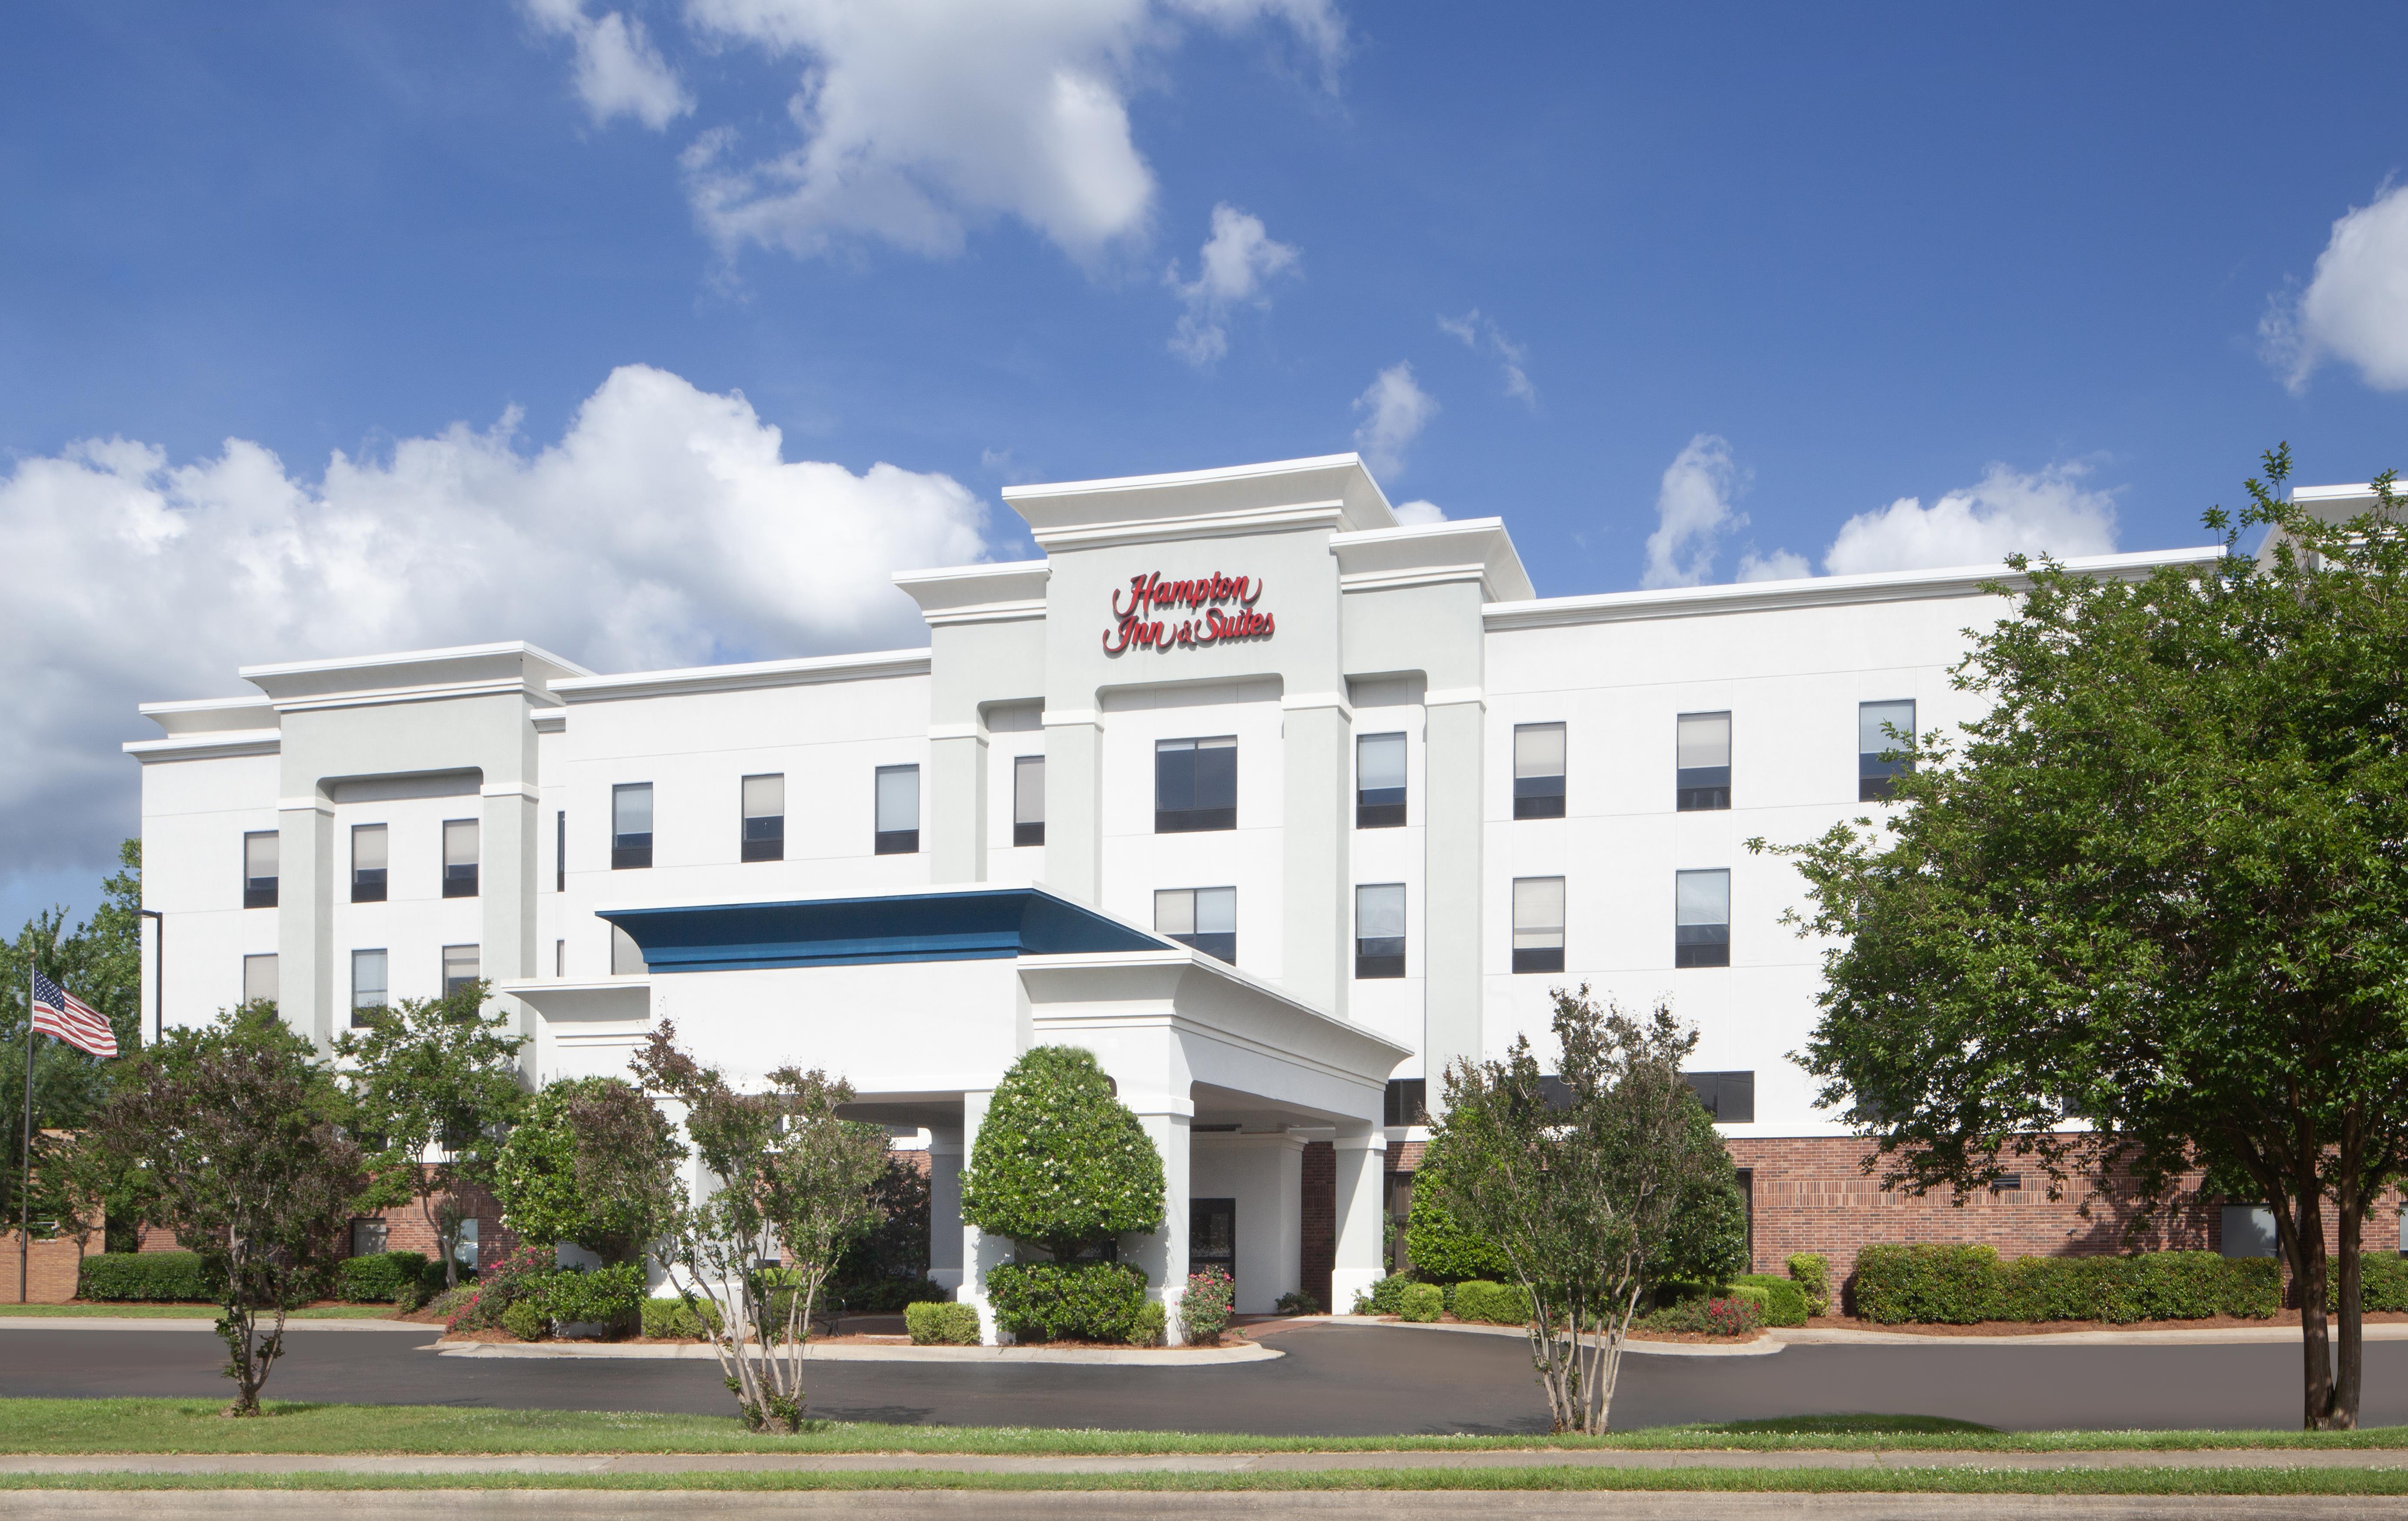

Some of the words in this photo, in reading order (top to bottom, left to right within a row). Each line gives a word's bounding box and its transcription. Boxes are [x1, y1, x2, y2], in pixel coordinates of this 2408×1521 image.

[1112, 571, 1262, 619] Hampton
[1103, 616, 1177, 652] Inn
[1177, 620, 1197, 645] &
[1194, 607, 1275, 642] Suites
